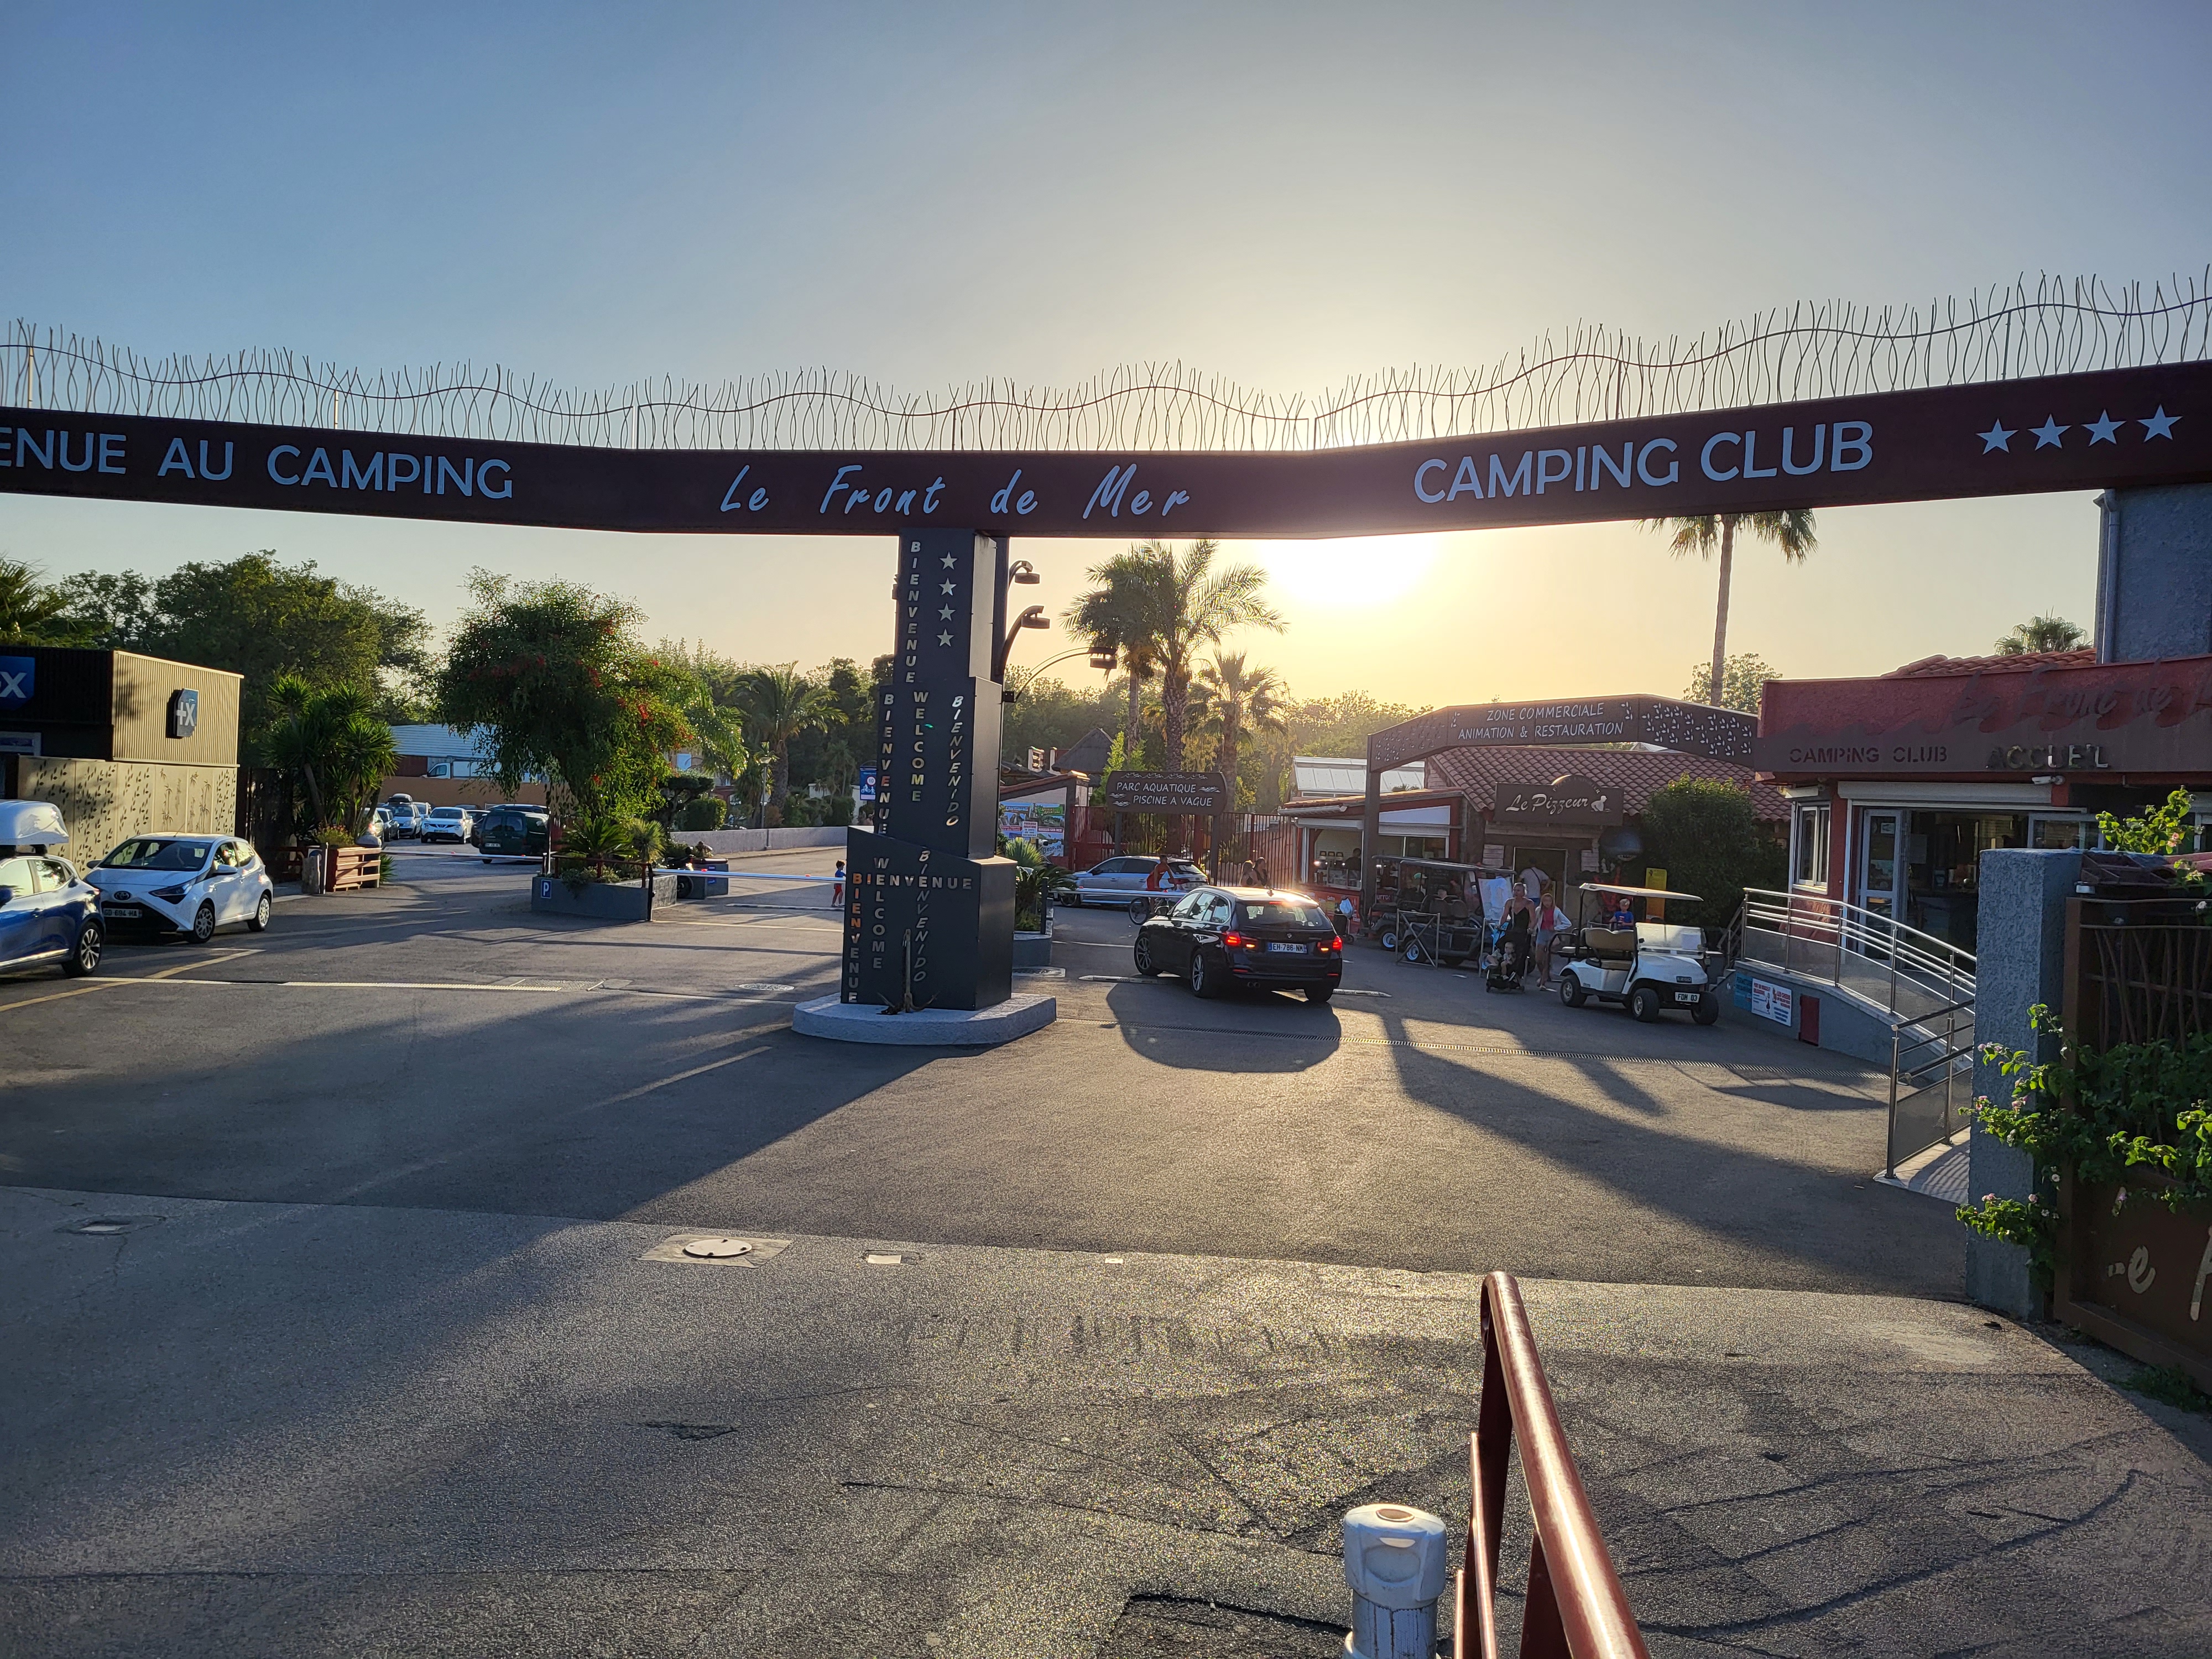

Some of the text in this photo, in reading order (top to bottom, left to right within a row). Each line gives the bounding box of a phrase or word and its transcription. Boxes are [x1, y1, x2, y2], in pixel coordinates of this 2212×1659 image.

[158, 437, 234, 481] AU
[267, 445, 513, 499] CAMPING
[719, 462, 1190, 520] Le Front de Mer
[1413, 420, 1874, 504] CAMPING CLUB
[905, 541, 921, 683] BIENVENUE
[1458, 721, 1624, 740] ANIMATION & RESTAURATION
[1486, 702, 1604, 721] ZONE COMMERCIALE
[878, 693, 894, 834] BIENVENUE
[911, 691, 929, 802] WELCOME
[945, 695, 964, 827] BIENVENIDO
[1790, 746, 1947, 763] CAMPING CLUB
[1117, 782, 1197, 793] PARC AQUATIQUE
[1133, 795, 1213, 807] PISCINE A VAGUE
[1505, 794, 1589, 815] Le Pizzeur
[543, 882, 549, 896] P
[852, 873, 972, 890] BIENVENUE
[848, 873, 863, 1003] BIENVENUE
[872, 857, 889, 969] WELCOME
[913, 849, 931, 982] BIENVENIDO
